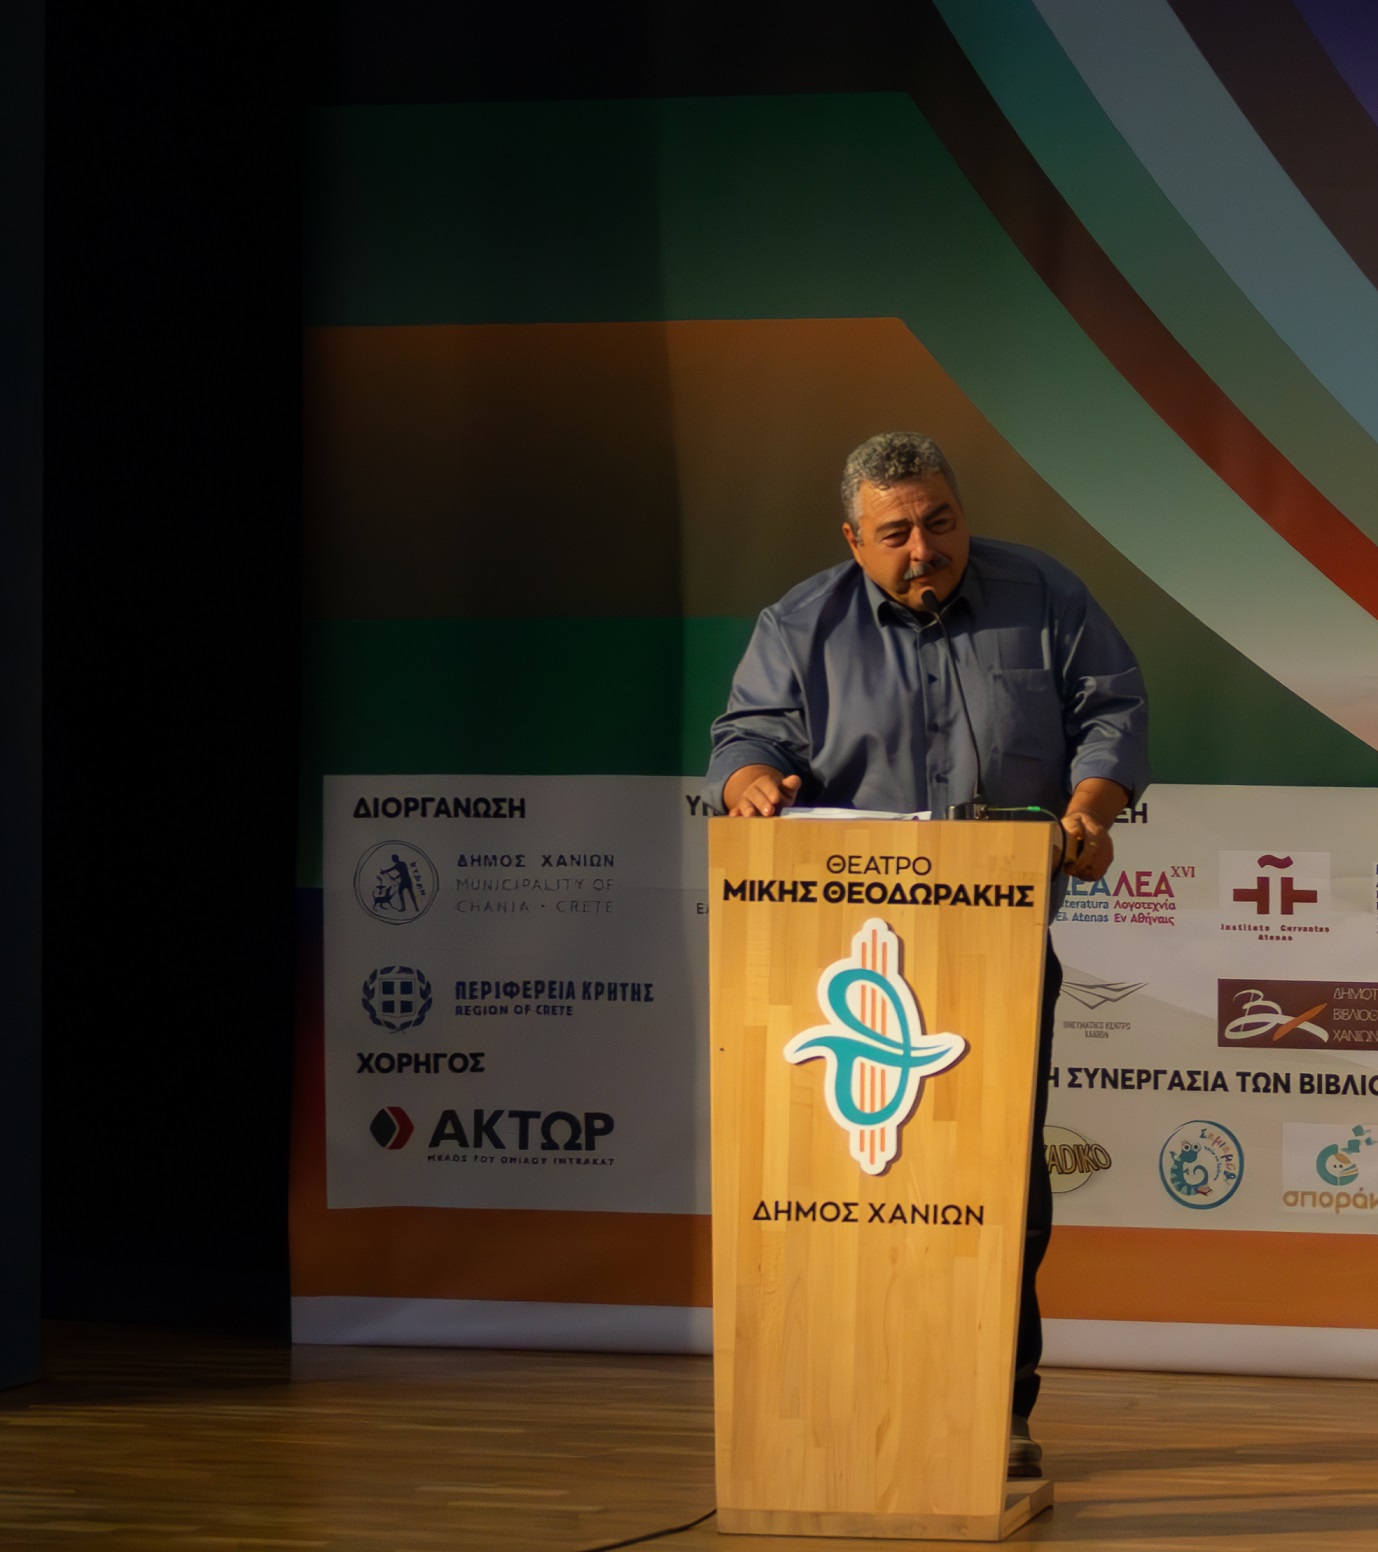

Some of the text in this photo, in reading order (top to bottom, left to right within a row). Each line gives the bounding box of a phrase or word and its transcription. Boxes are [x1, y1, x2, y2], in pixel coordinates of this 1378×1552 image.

[353, 797, 526, 819] ΔΙΟΡΓΑΝΩΣΗ
[457, 854, 615, 868] ΔΗΜΟΣ ΧΑΝΙΩΝ
[827, 855, 931, 875] ΘΕΑΤΡΟ
[456, 878, 614, 891] MUNICIPALITY OF
[723, 879, 1034, 907] ΜΙΚΗΣ ΘΕΟΔΩΡΑΚΗΣ
[454, 901, 613, 914] CHANIA CRETE
[1114, 899, 1176, 912] Λογοτεχνία
[1072, 912, 1109, 922] Atenas
[1114, 912, 1175, 926] Εν Αθήναις
[1280, 925, 1330, 933] Cervantes
[455, 981, 654, 1002] ΠΕΡΙΦΕΡΕΙΑ ΚΡΗΤΗΣ
[455, 1005, 573, 1016] REGION OF CRETE
[356, 1053, 485, 1073] ΧΟΡΗΓΟΣ
[1067, 1068, 1227, 1092] ΣΥΝΕΡΓΑΣΙΑ
[1236, 1071, 1291, 1094] ΤΩΝ
[428, 1109, 615, 1150] ΑΚΤΩΡ
[1044, 1144, 1112, 1175] ADIKO
[753, 1201, 984, 1226] ΔΗΜΟΣ ΧΑΝΙΩΝ
